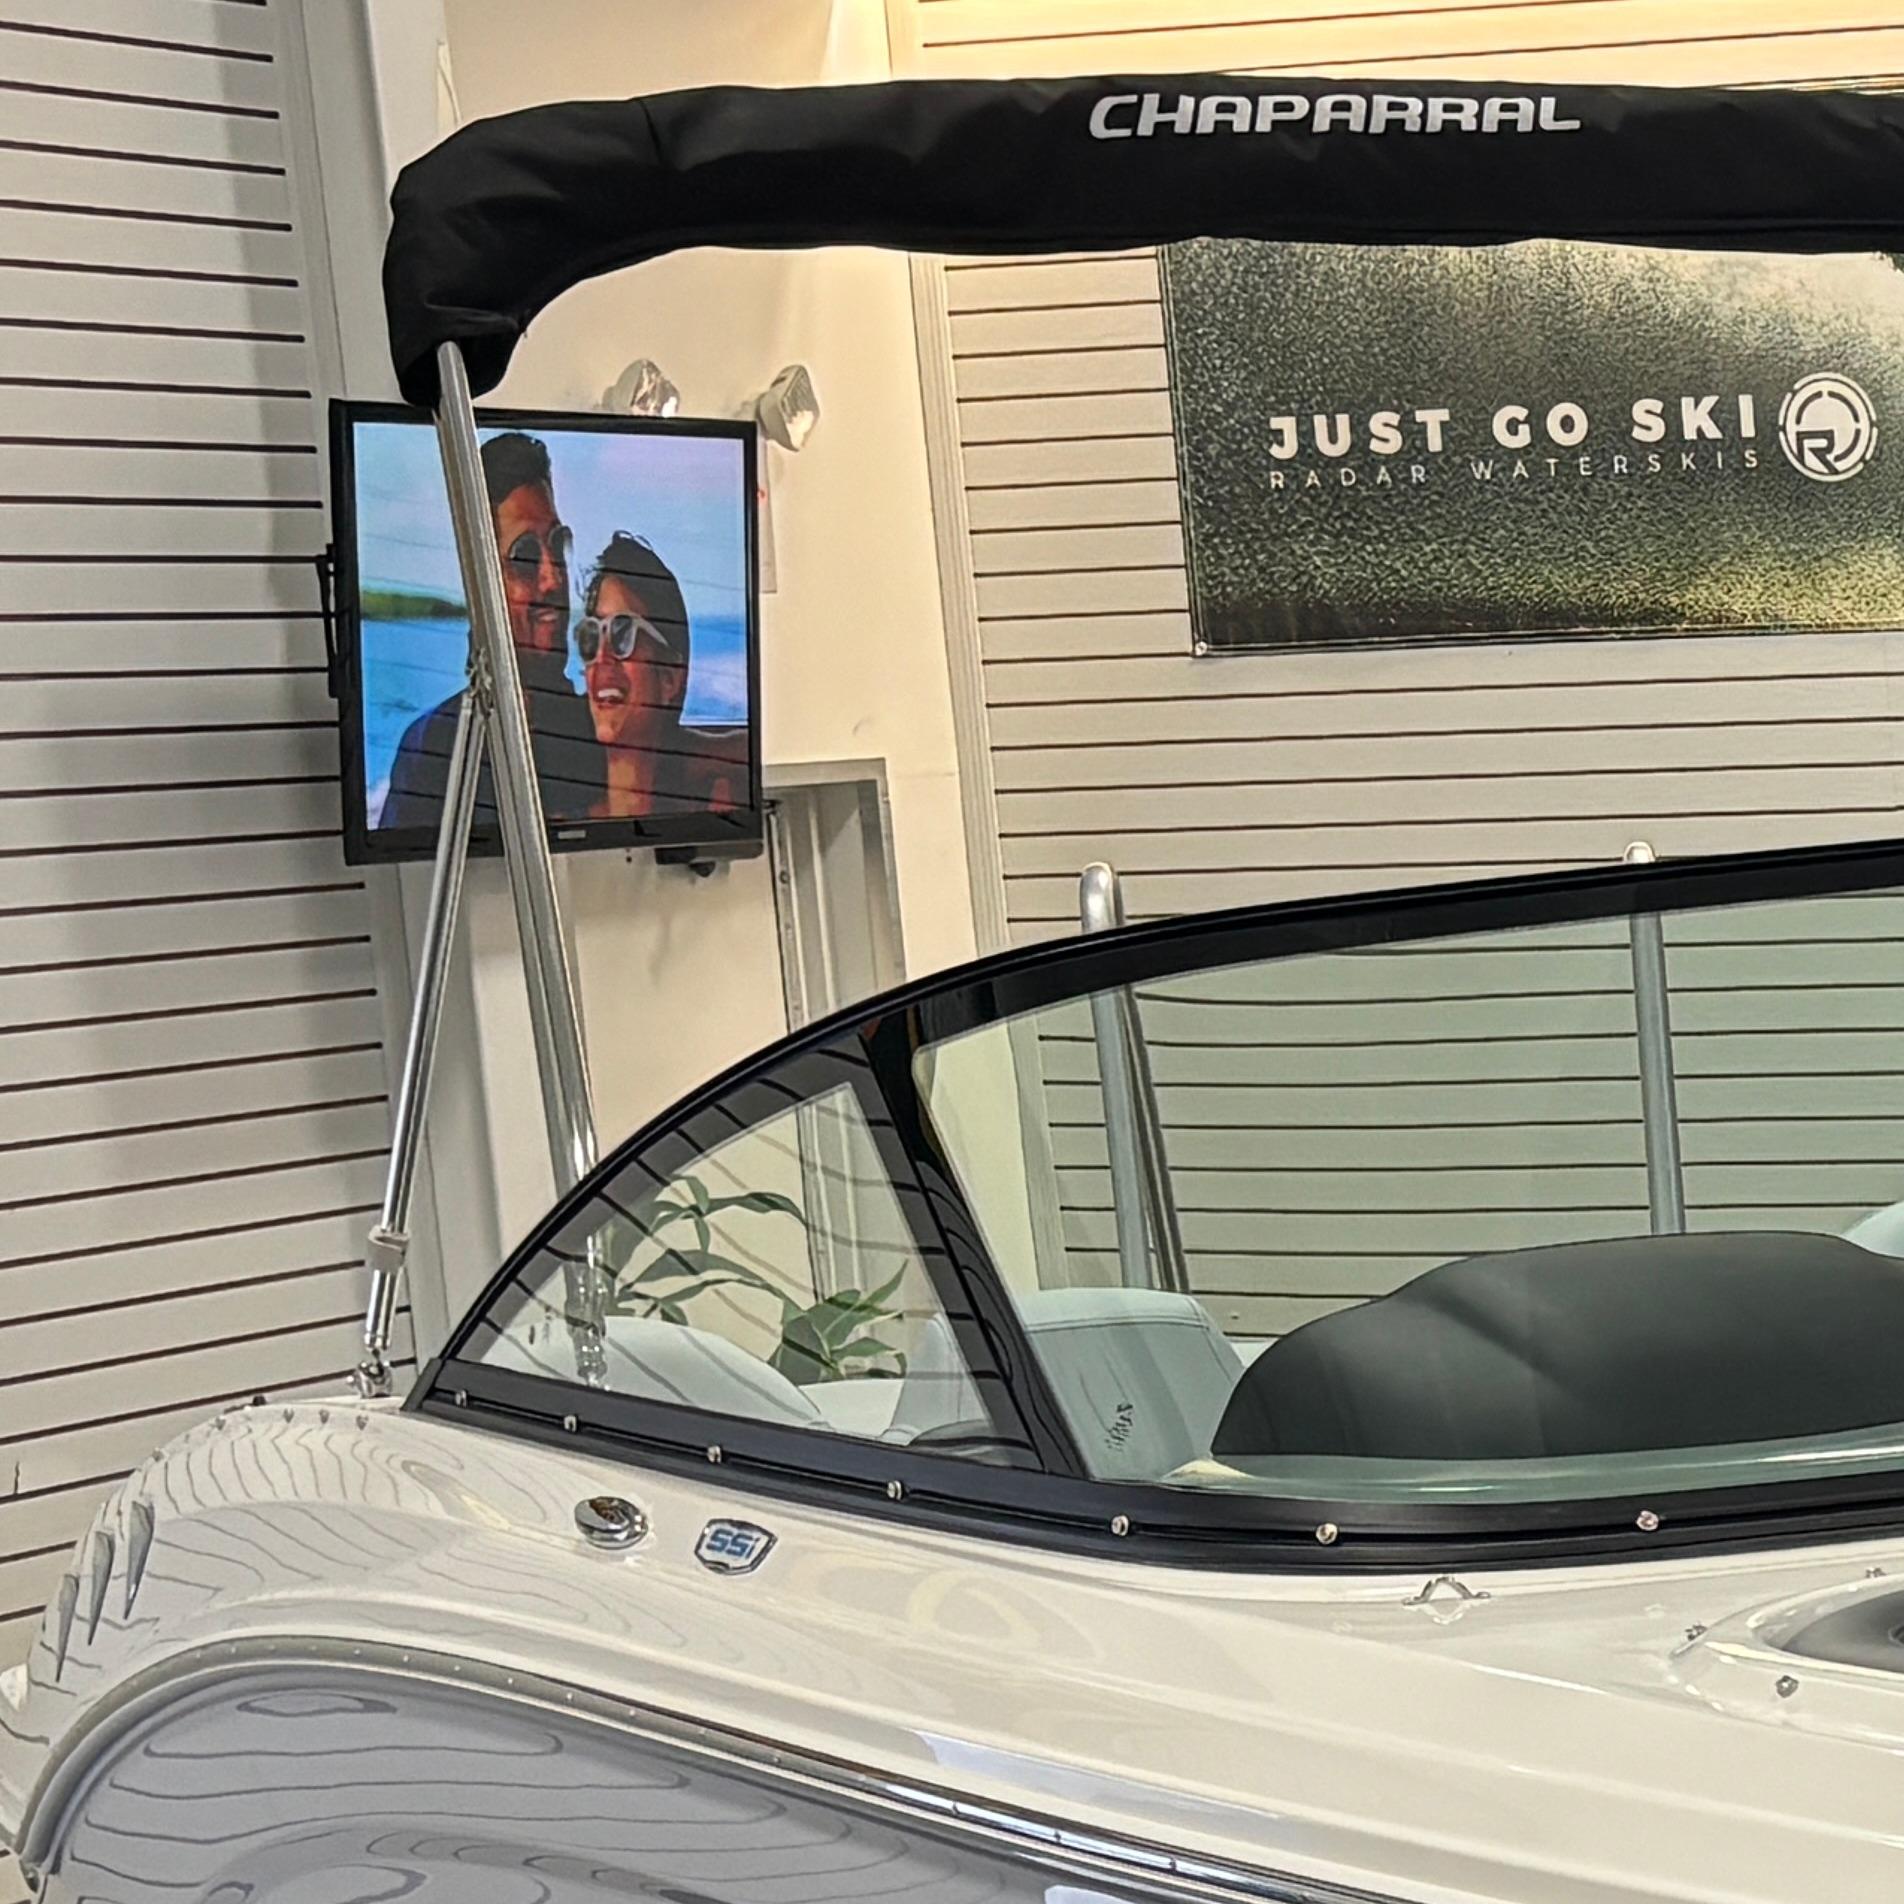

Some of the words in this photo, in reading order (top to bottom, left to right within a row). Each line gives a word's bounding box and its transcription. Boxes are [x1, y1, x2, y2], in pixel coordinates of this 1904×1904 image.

[1088, 94, 1581, 139] CHAPARRAL
[1269, 408, 1451, 460] JUST
[1493, 402, 1589, 449] GO
[1632, 393, 1756, 442] SKI
[1271, 464, 1428, 489] RADAR
[1470, 448, 1760, 481] WATERSKIS
[706, 1528, 760, 1558] SSi
